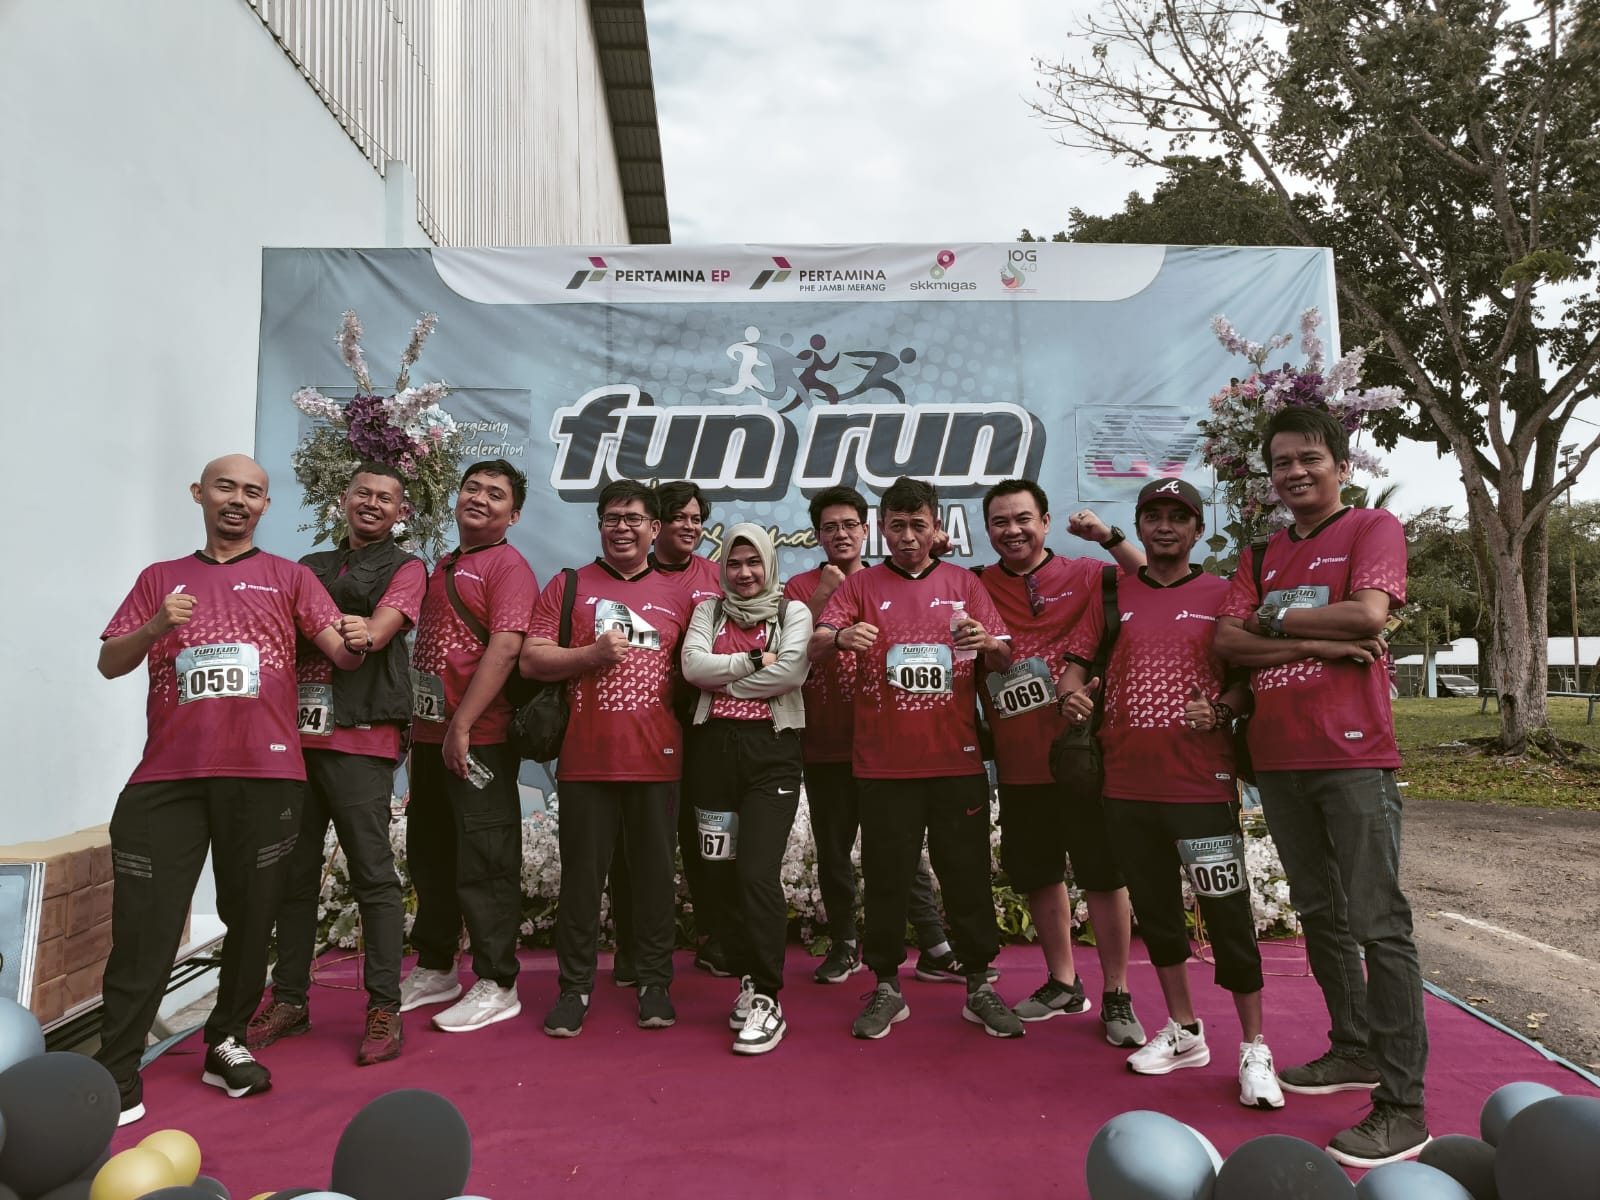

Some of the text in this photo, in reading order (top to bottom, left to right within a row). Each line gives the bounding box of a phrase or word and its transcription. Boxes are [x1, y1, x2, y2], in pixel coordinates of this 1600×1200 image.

[1008, 250, 1037, 262] IOG
[615, 270, 730, 282] PERTAMINA EP
[799, 270, 886, 282] PERTAMINA
[849, 284, 886, 292] MERANG
[910, 281, 977, 293] skkmigas
[455, 421, 509, 440] ergizing
[551, 384, 1034, 490] fun run
[194, 646, 240, 657] fun run
[191, 668, 244, 695] 059
[900, 667, 942, 689] 068
[1003, 681, 1045, 711] 069
[297, 707, 322, 730] 64
[1191, 839, 1233, 850] fun run
[1195, 862, 1240, 892] 063
